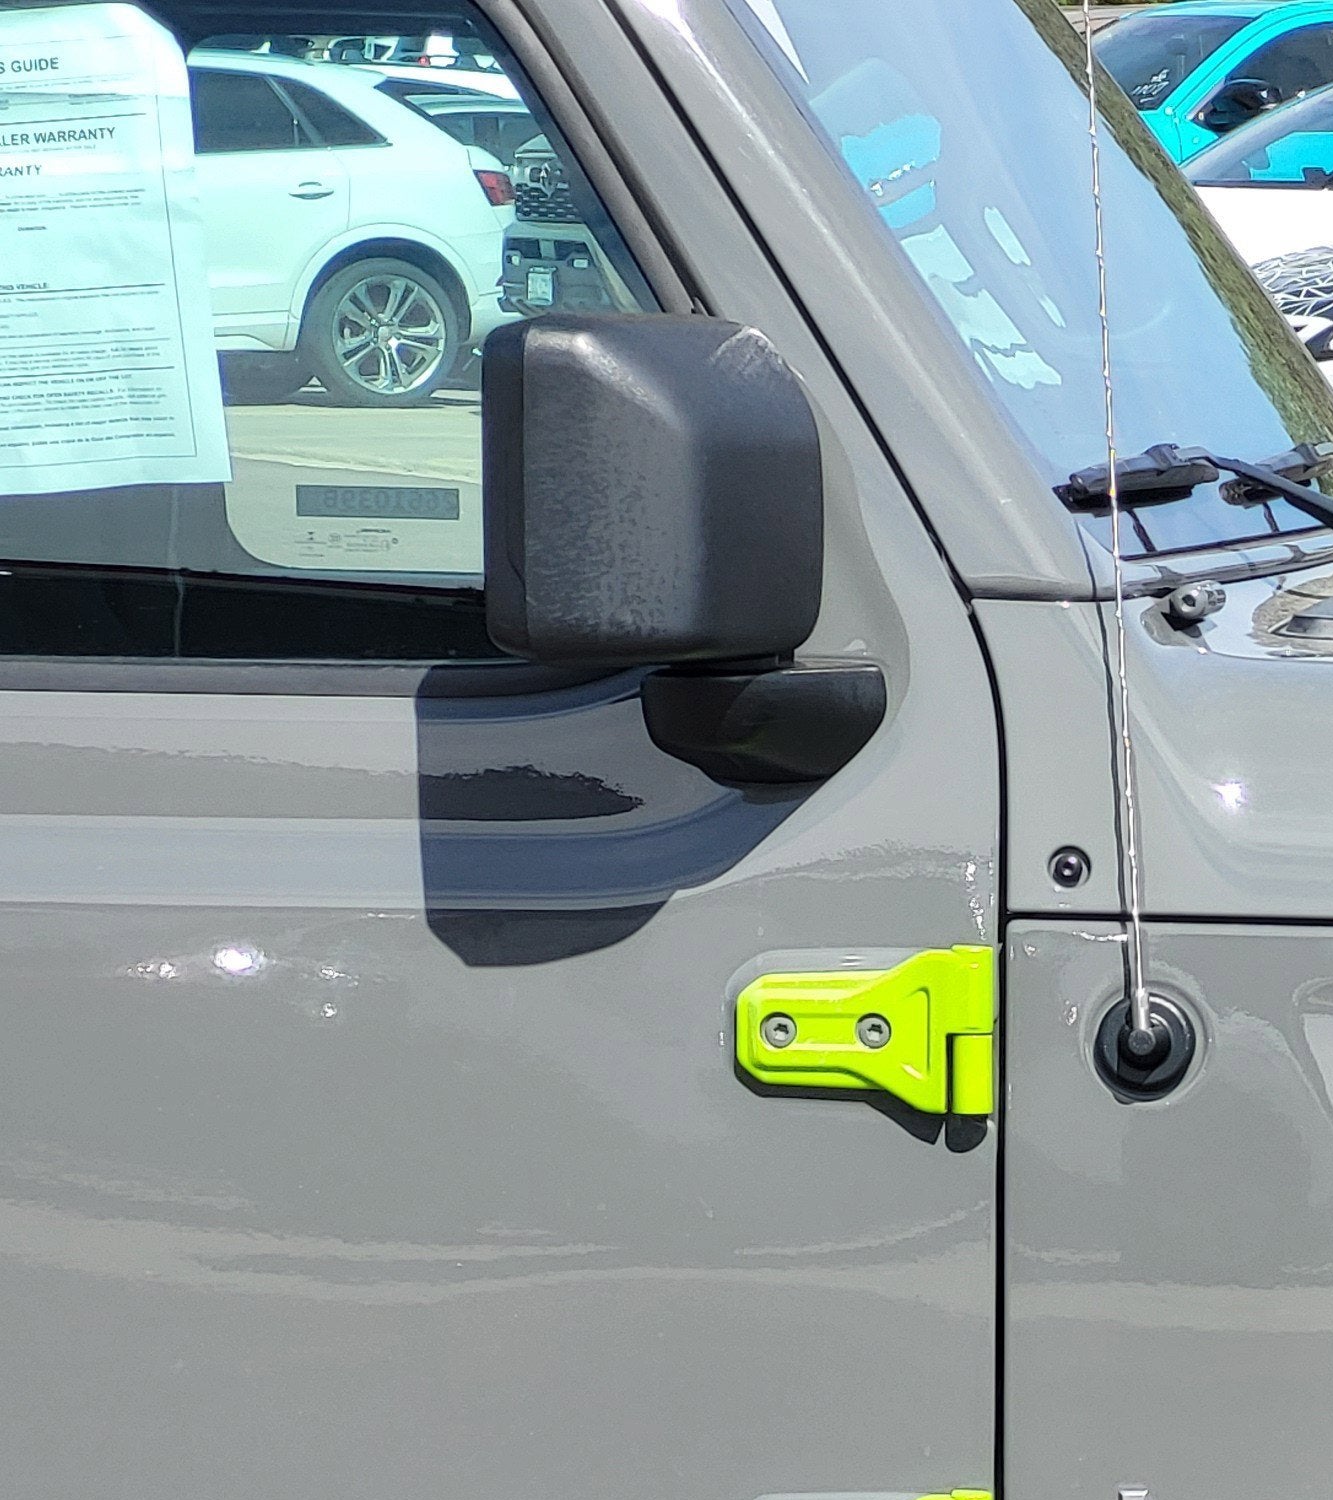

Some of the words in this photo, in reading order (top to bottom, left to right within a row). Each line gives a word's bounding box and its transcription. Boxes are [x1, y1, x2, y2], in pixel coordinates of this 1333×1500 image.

[11, 57, 59, 73] GUIDE
[0, 133, 31, 147] LER
[34, 126, 116, 144] WARRANTY
